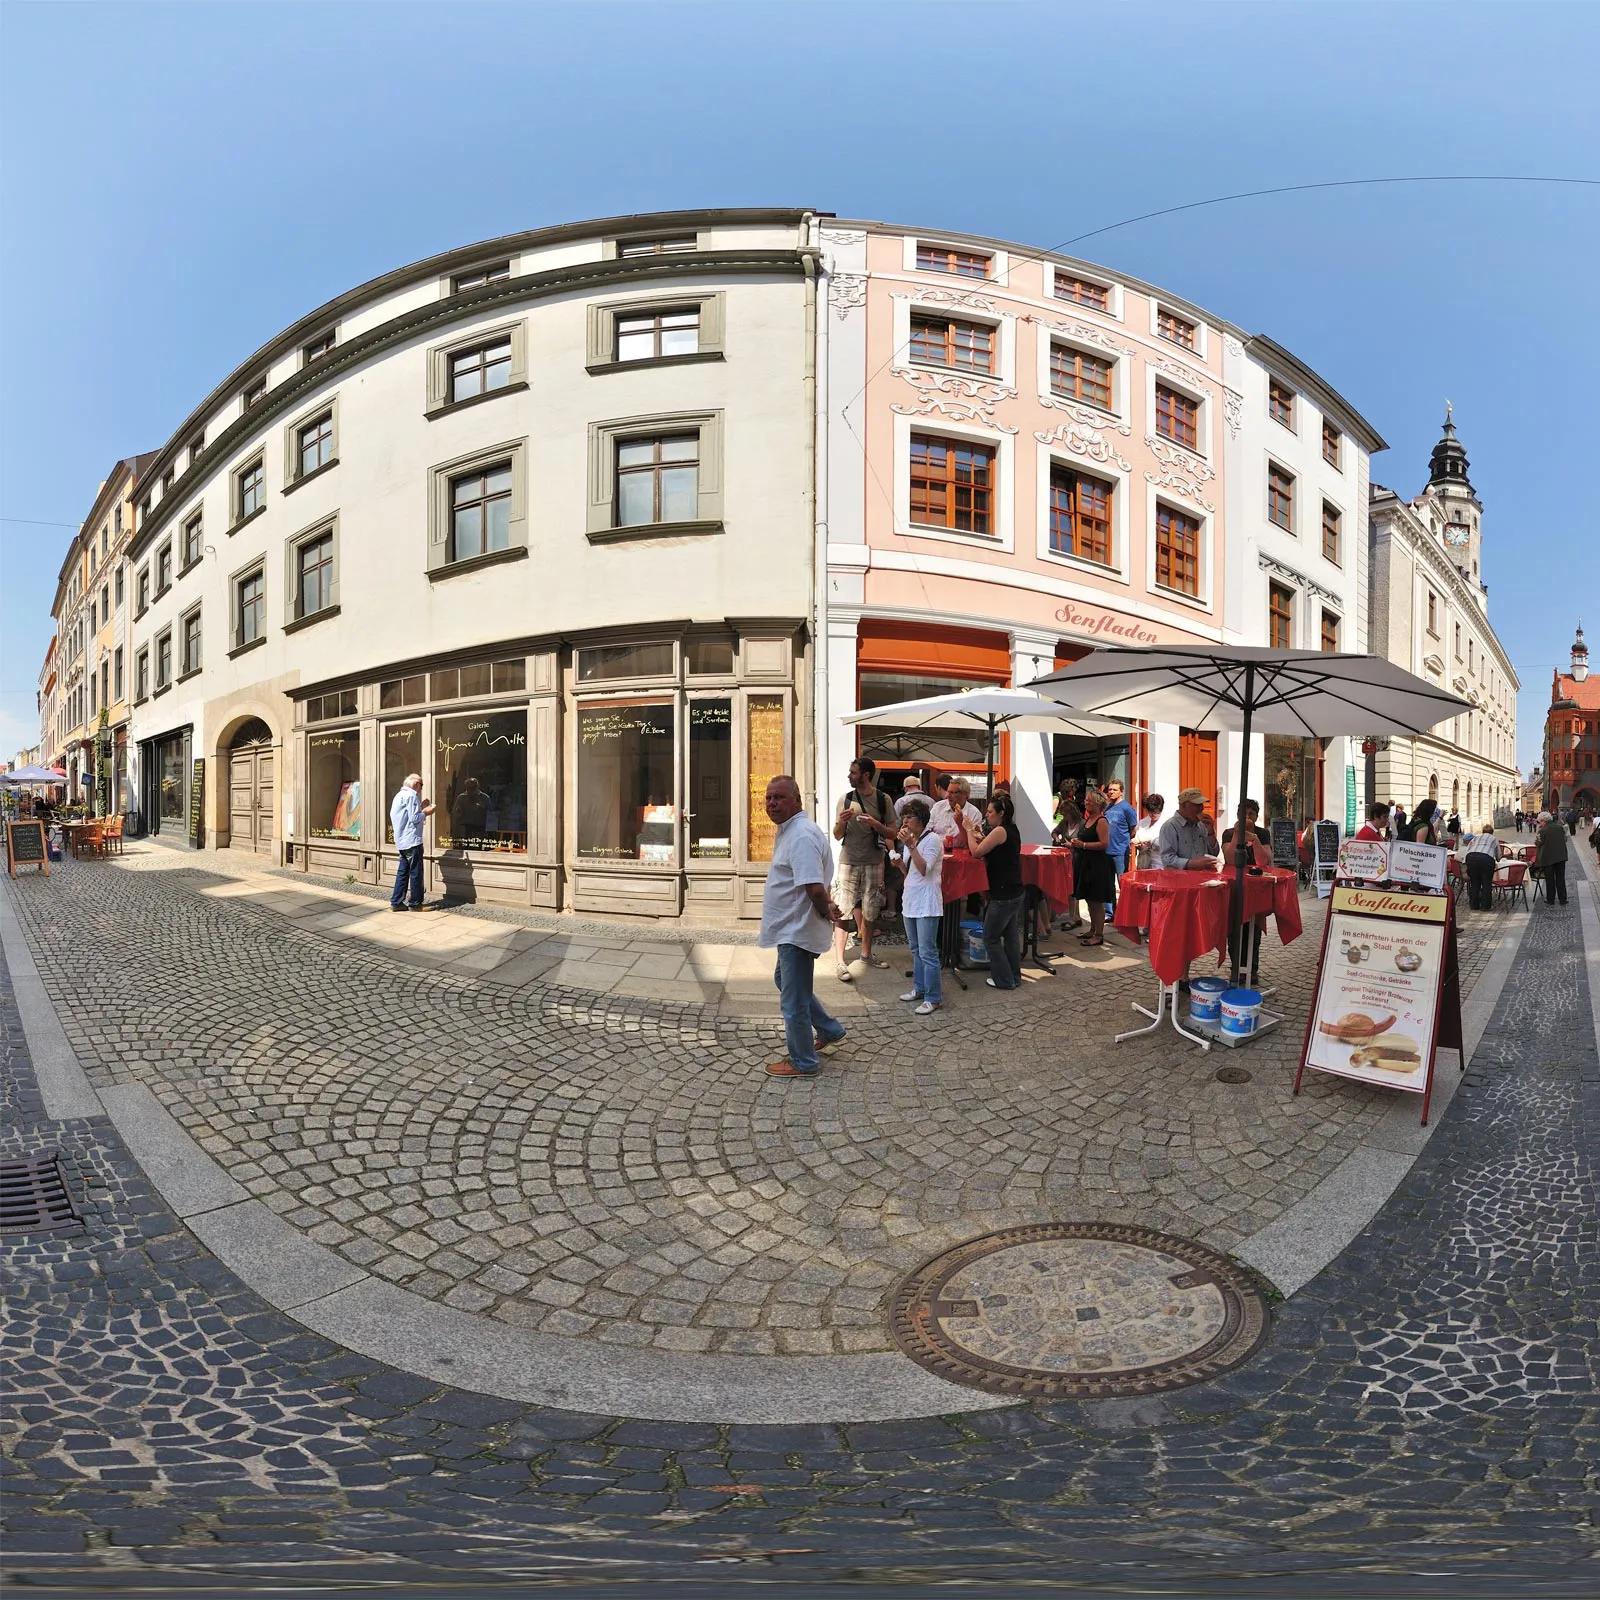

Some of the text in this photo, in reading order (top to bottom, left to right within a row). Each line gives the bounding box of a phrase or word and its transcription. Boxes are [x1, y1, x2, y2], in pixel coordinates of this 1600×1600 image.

[1055, 604, 1158, 643] Senfladen
[468, 721, 490, 730] Galerie
[1399, 846, 1437, 859] Fleischkäse
[1347, 892, 1431, 914] Senfladen
[1342, 929, 1428, 947] Im schärfsten Laden der
[1373, 941, 1393, 951] Stadt
[1388, 976, 1412, 986] Getränke
[1361, 993, 1389, 1004] Bockwurst
[1362, 986, 1387, 996] Thüringer
[1387, 991, 1414, 1004] Bratwurst
